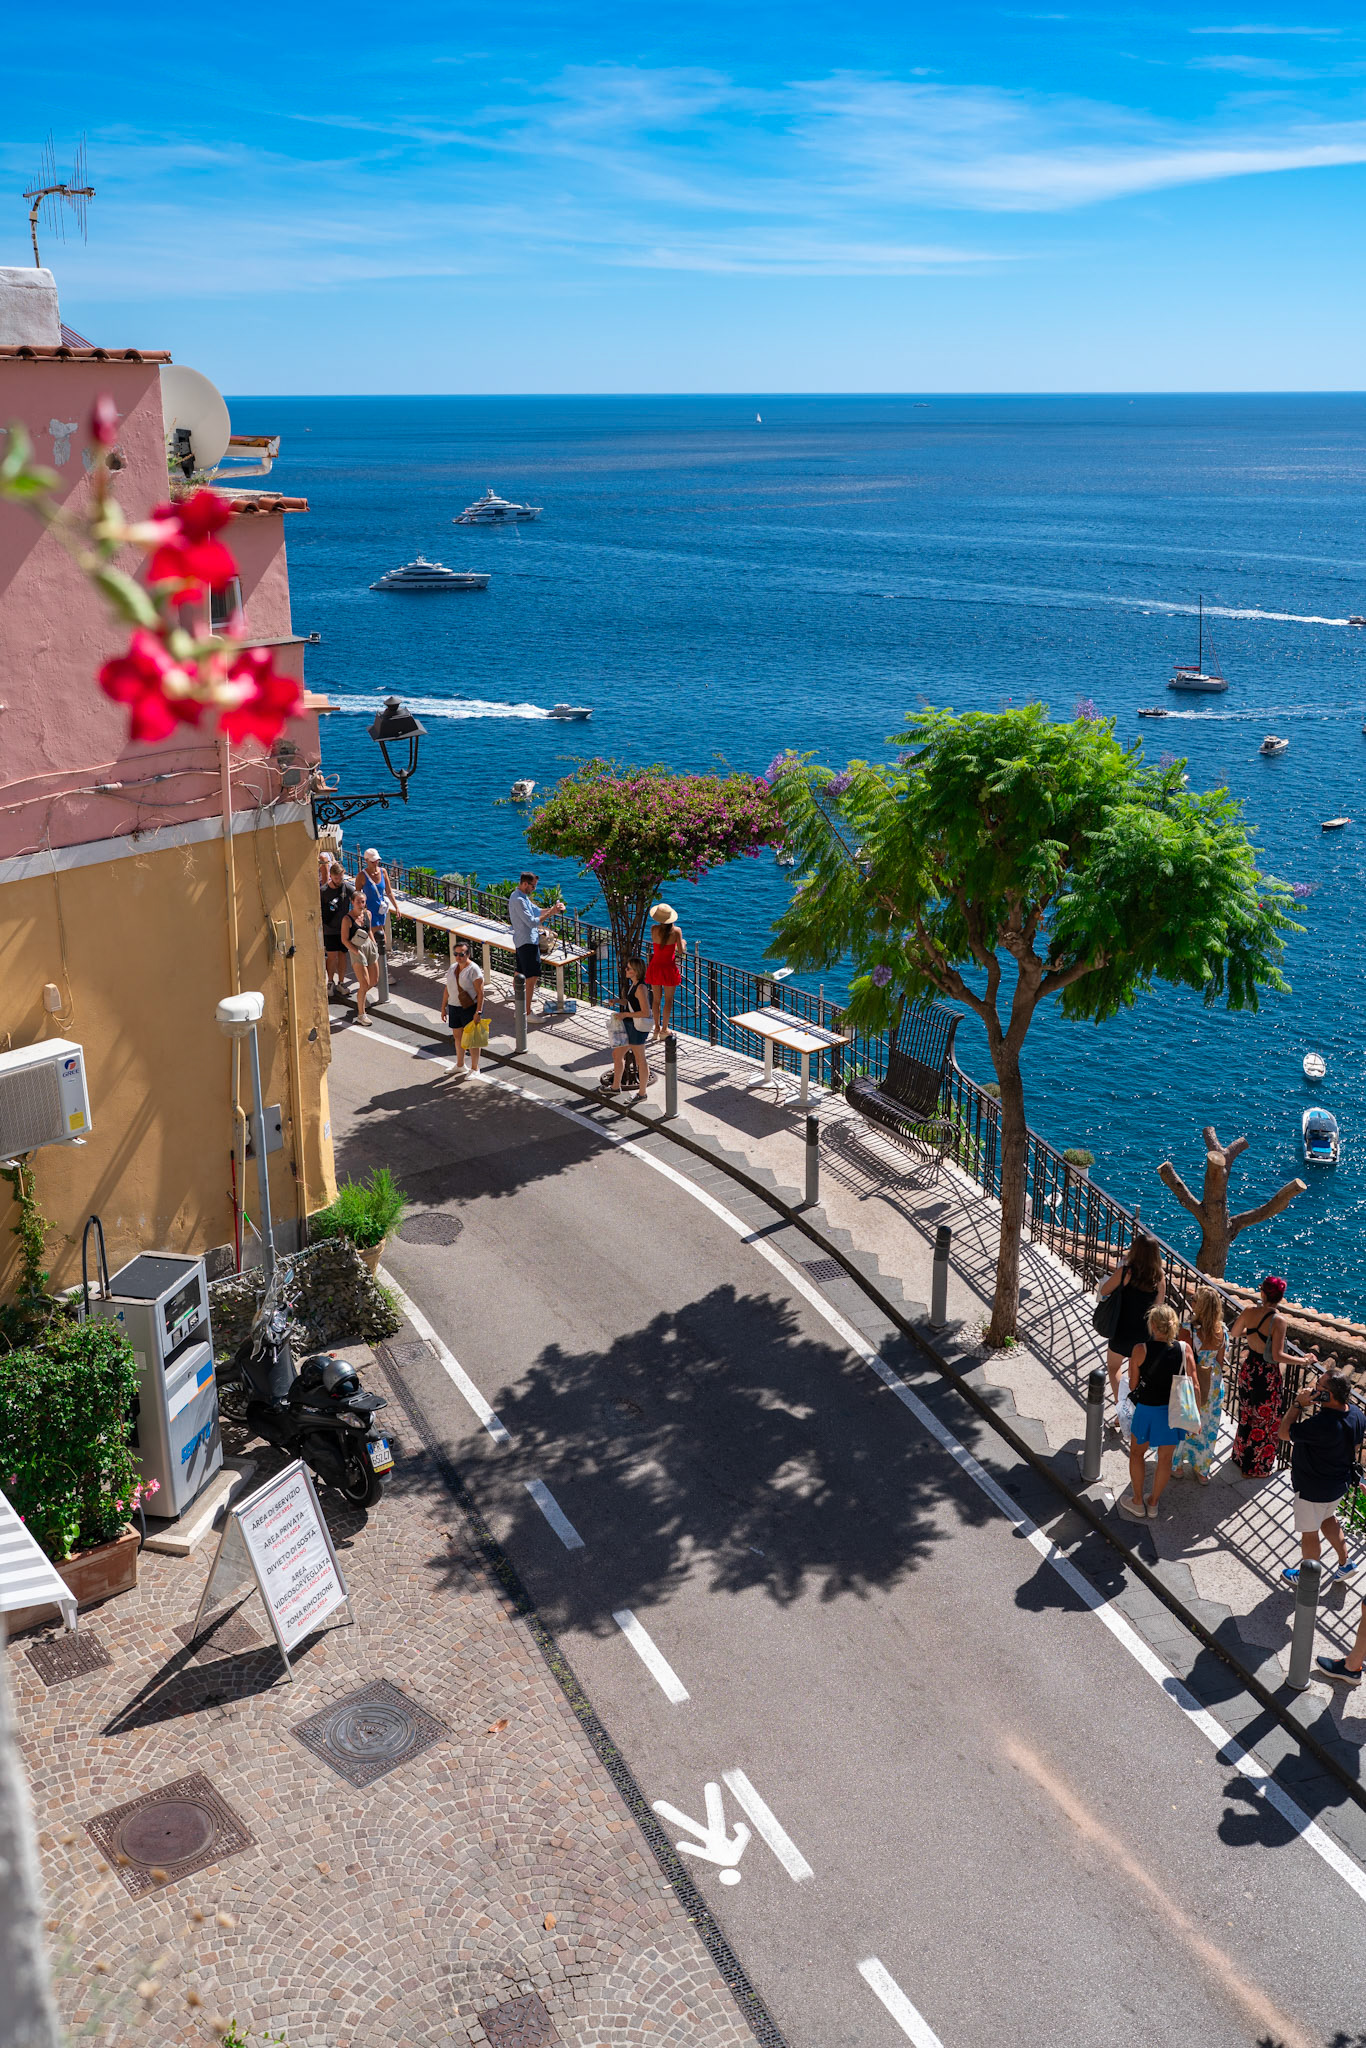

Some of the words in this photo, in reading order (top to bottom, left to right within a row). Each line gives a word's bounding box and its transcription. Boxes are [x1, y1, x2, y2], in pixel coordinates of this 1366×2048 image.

[62, 1068, 80, 1077] GREE
[117, 1311, 124, 1322] 4
[251, 1514, 268, 1530] AREA
[275, 1486, 300, 1511] SERVIZIO
[264, 1512, 282, 1528] SERVICE
[281, 1503, 293, 1514] AREA
[264, 1532, 280, 1549] AREA
[280, 1511, 304, 1535] PRIVATA
[272, 1533, 290, 1550] PRIVATE
[290, 1524, 301, 1535] AREA
[266, 1551, 290, 1575] DIVIETO
[297, 1529, 316, 1548] SOSTA
[288, 1547, 307, 1565] PARKING
[274, 1557, 330, 1610] VIDEOSORVEGLIATA
[291, 1566, 307, 1582] AREA
[278, 1602, 292, 1615] VIDEO
[320, 1566, 332, 1578] AREA
[286, 1610, 304, 1628] ZONA
[303, 1581, 334, 1613] RIMOZIONE
[297, 1608, 317, 1627] REMOVAL
[317, 1597, 328, 1609] AREA
